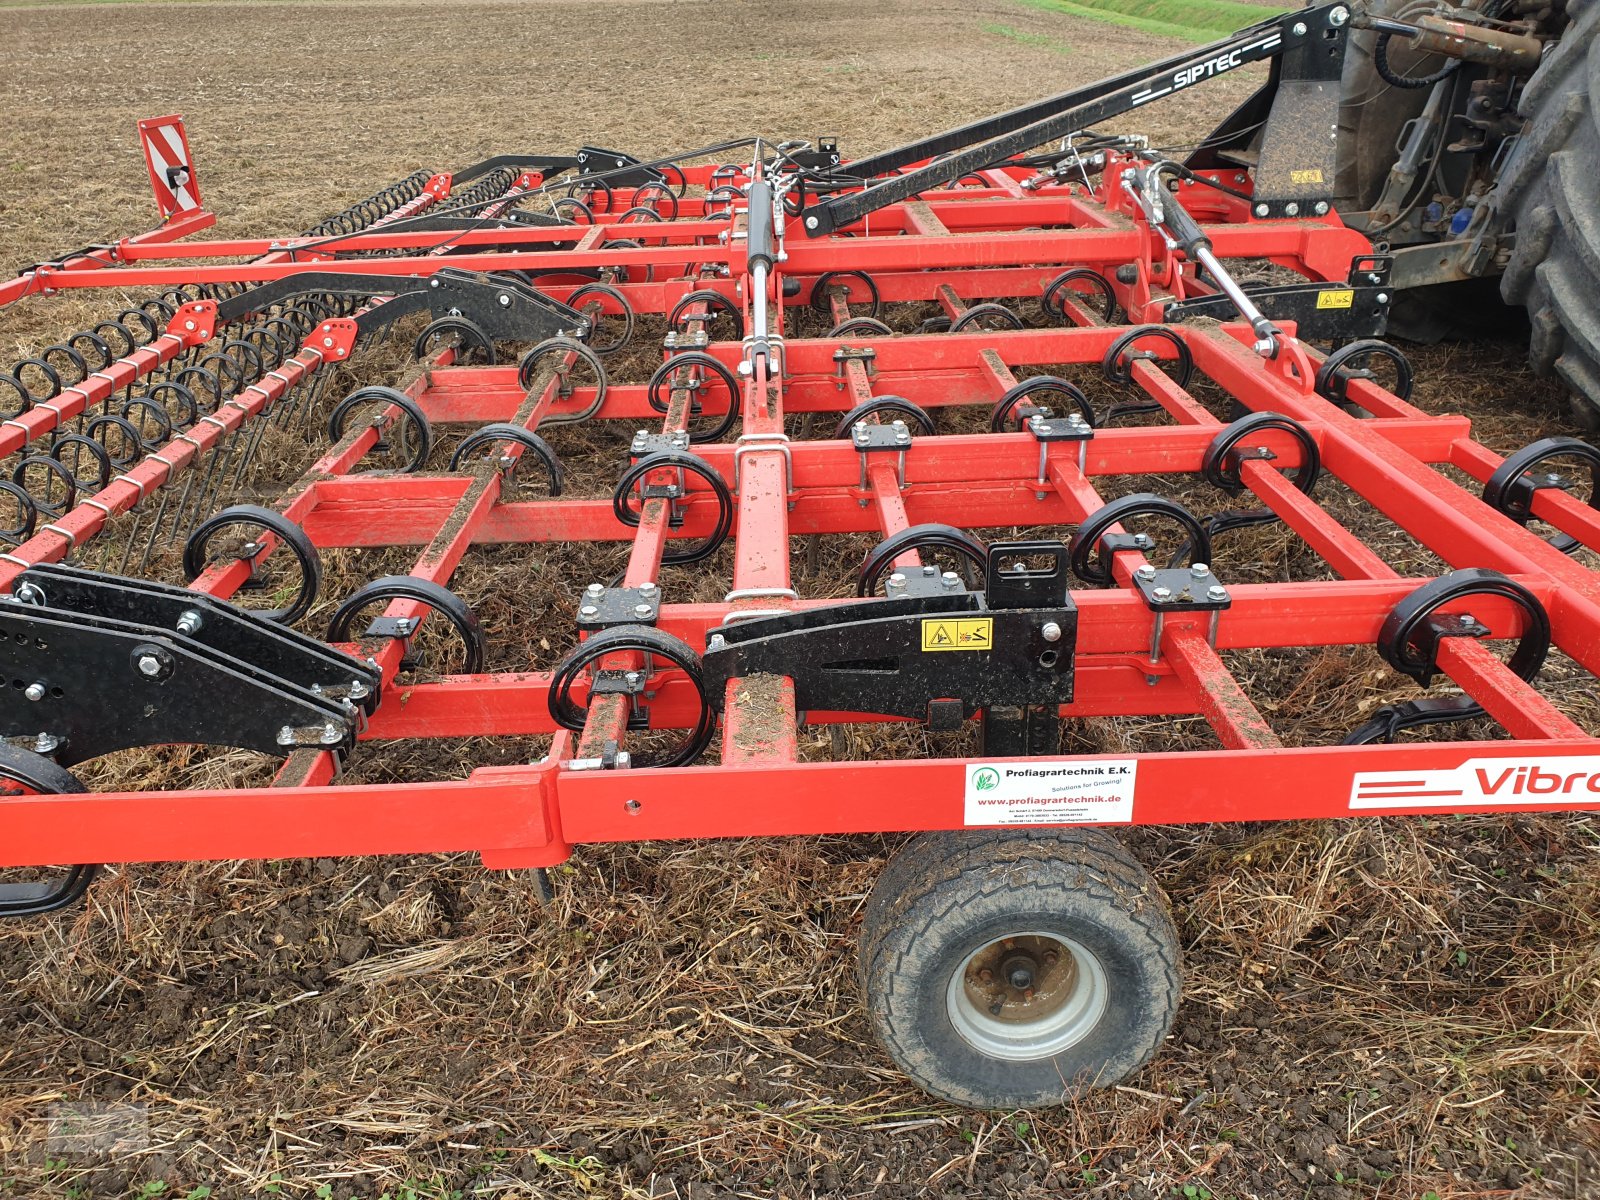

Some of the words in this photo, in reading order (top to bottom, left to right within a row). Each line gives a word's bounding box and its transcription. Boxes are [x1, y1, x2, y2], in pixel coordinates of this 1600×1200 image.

[1174, 49, 1241, 90] SIPTEC
[1006, 768, 1104, 777] Profiagrartechnik
[1108, 767, 1131, 775] E.K.
[1051, 783, 1081, 792] Solutions
[1093, 778, 1122, 787] Growing!
[978, 795, 1121, 806] www.profiagrartechnik.de
